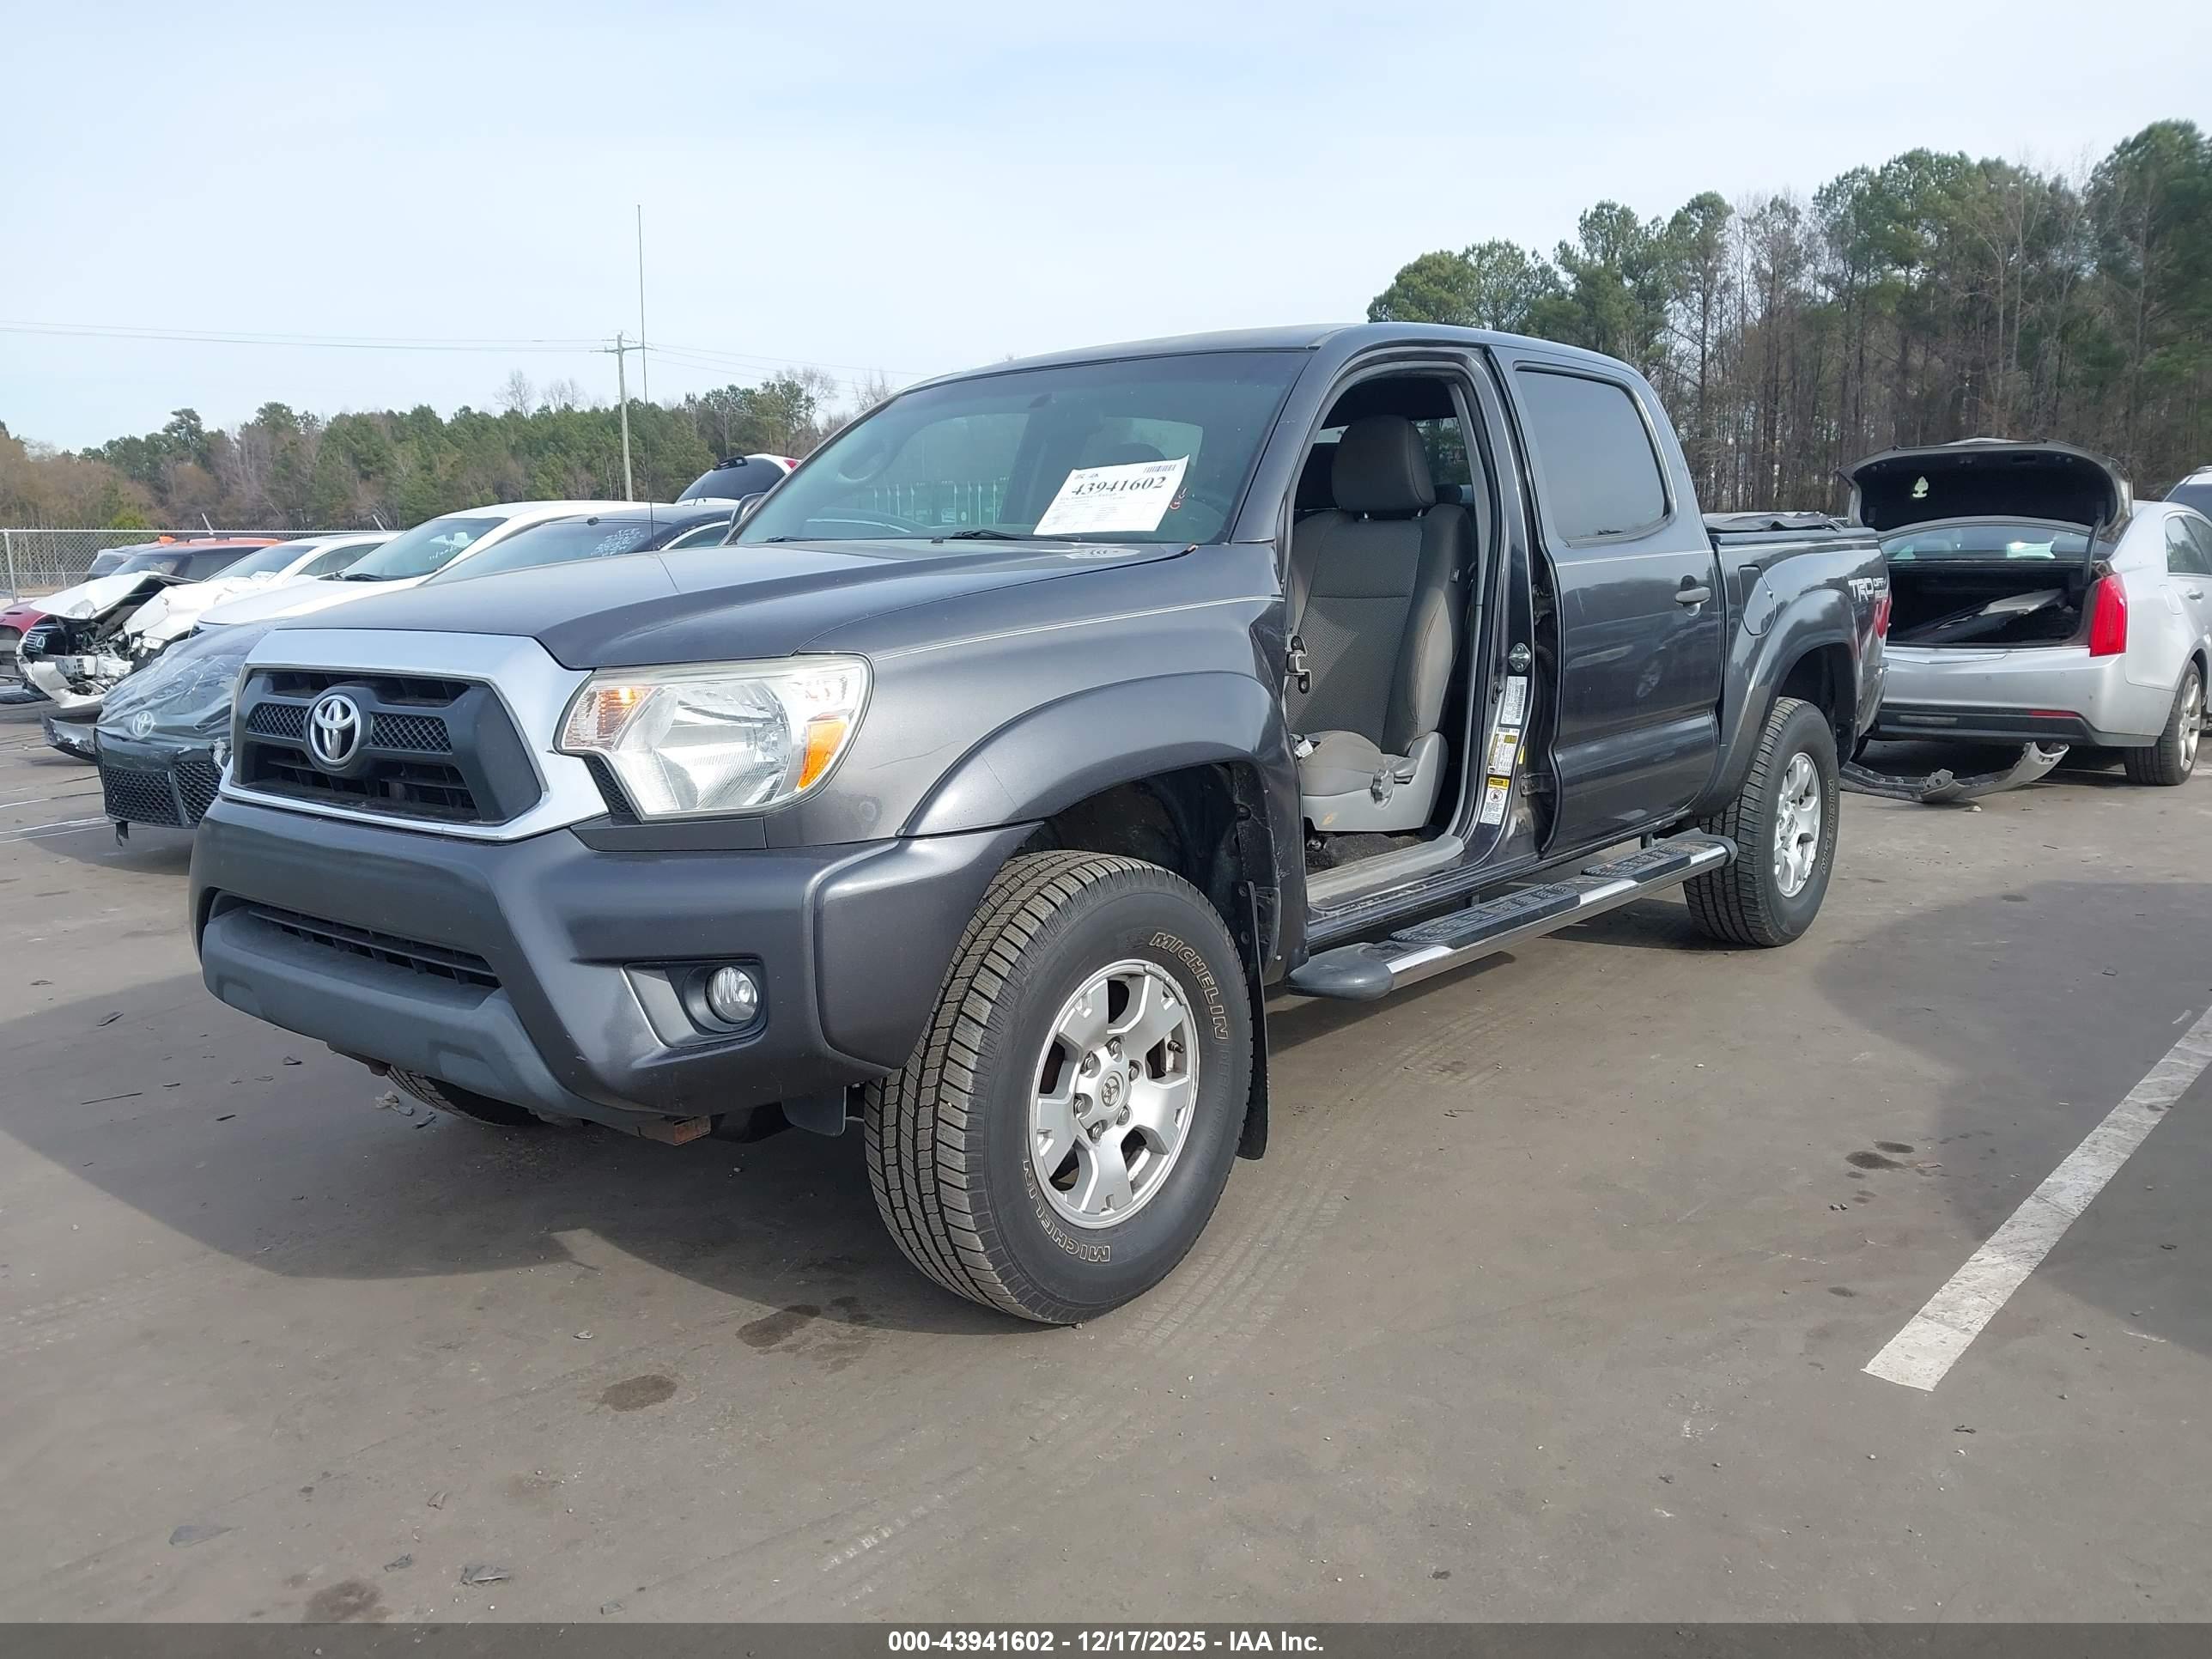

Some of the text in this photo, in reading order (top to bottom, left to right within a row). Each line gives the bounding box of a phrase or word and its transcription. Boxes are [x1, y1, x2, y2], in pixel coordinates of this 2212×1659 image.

[1072, 476, 1167, 495] 43941602
[1848, 577, 1875, 603] TRD
[1149, 932, 1229, 1040] MICHELIN
[1023, 1159, 1111, 1262] MICHELIN
